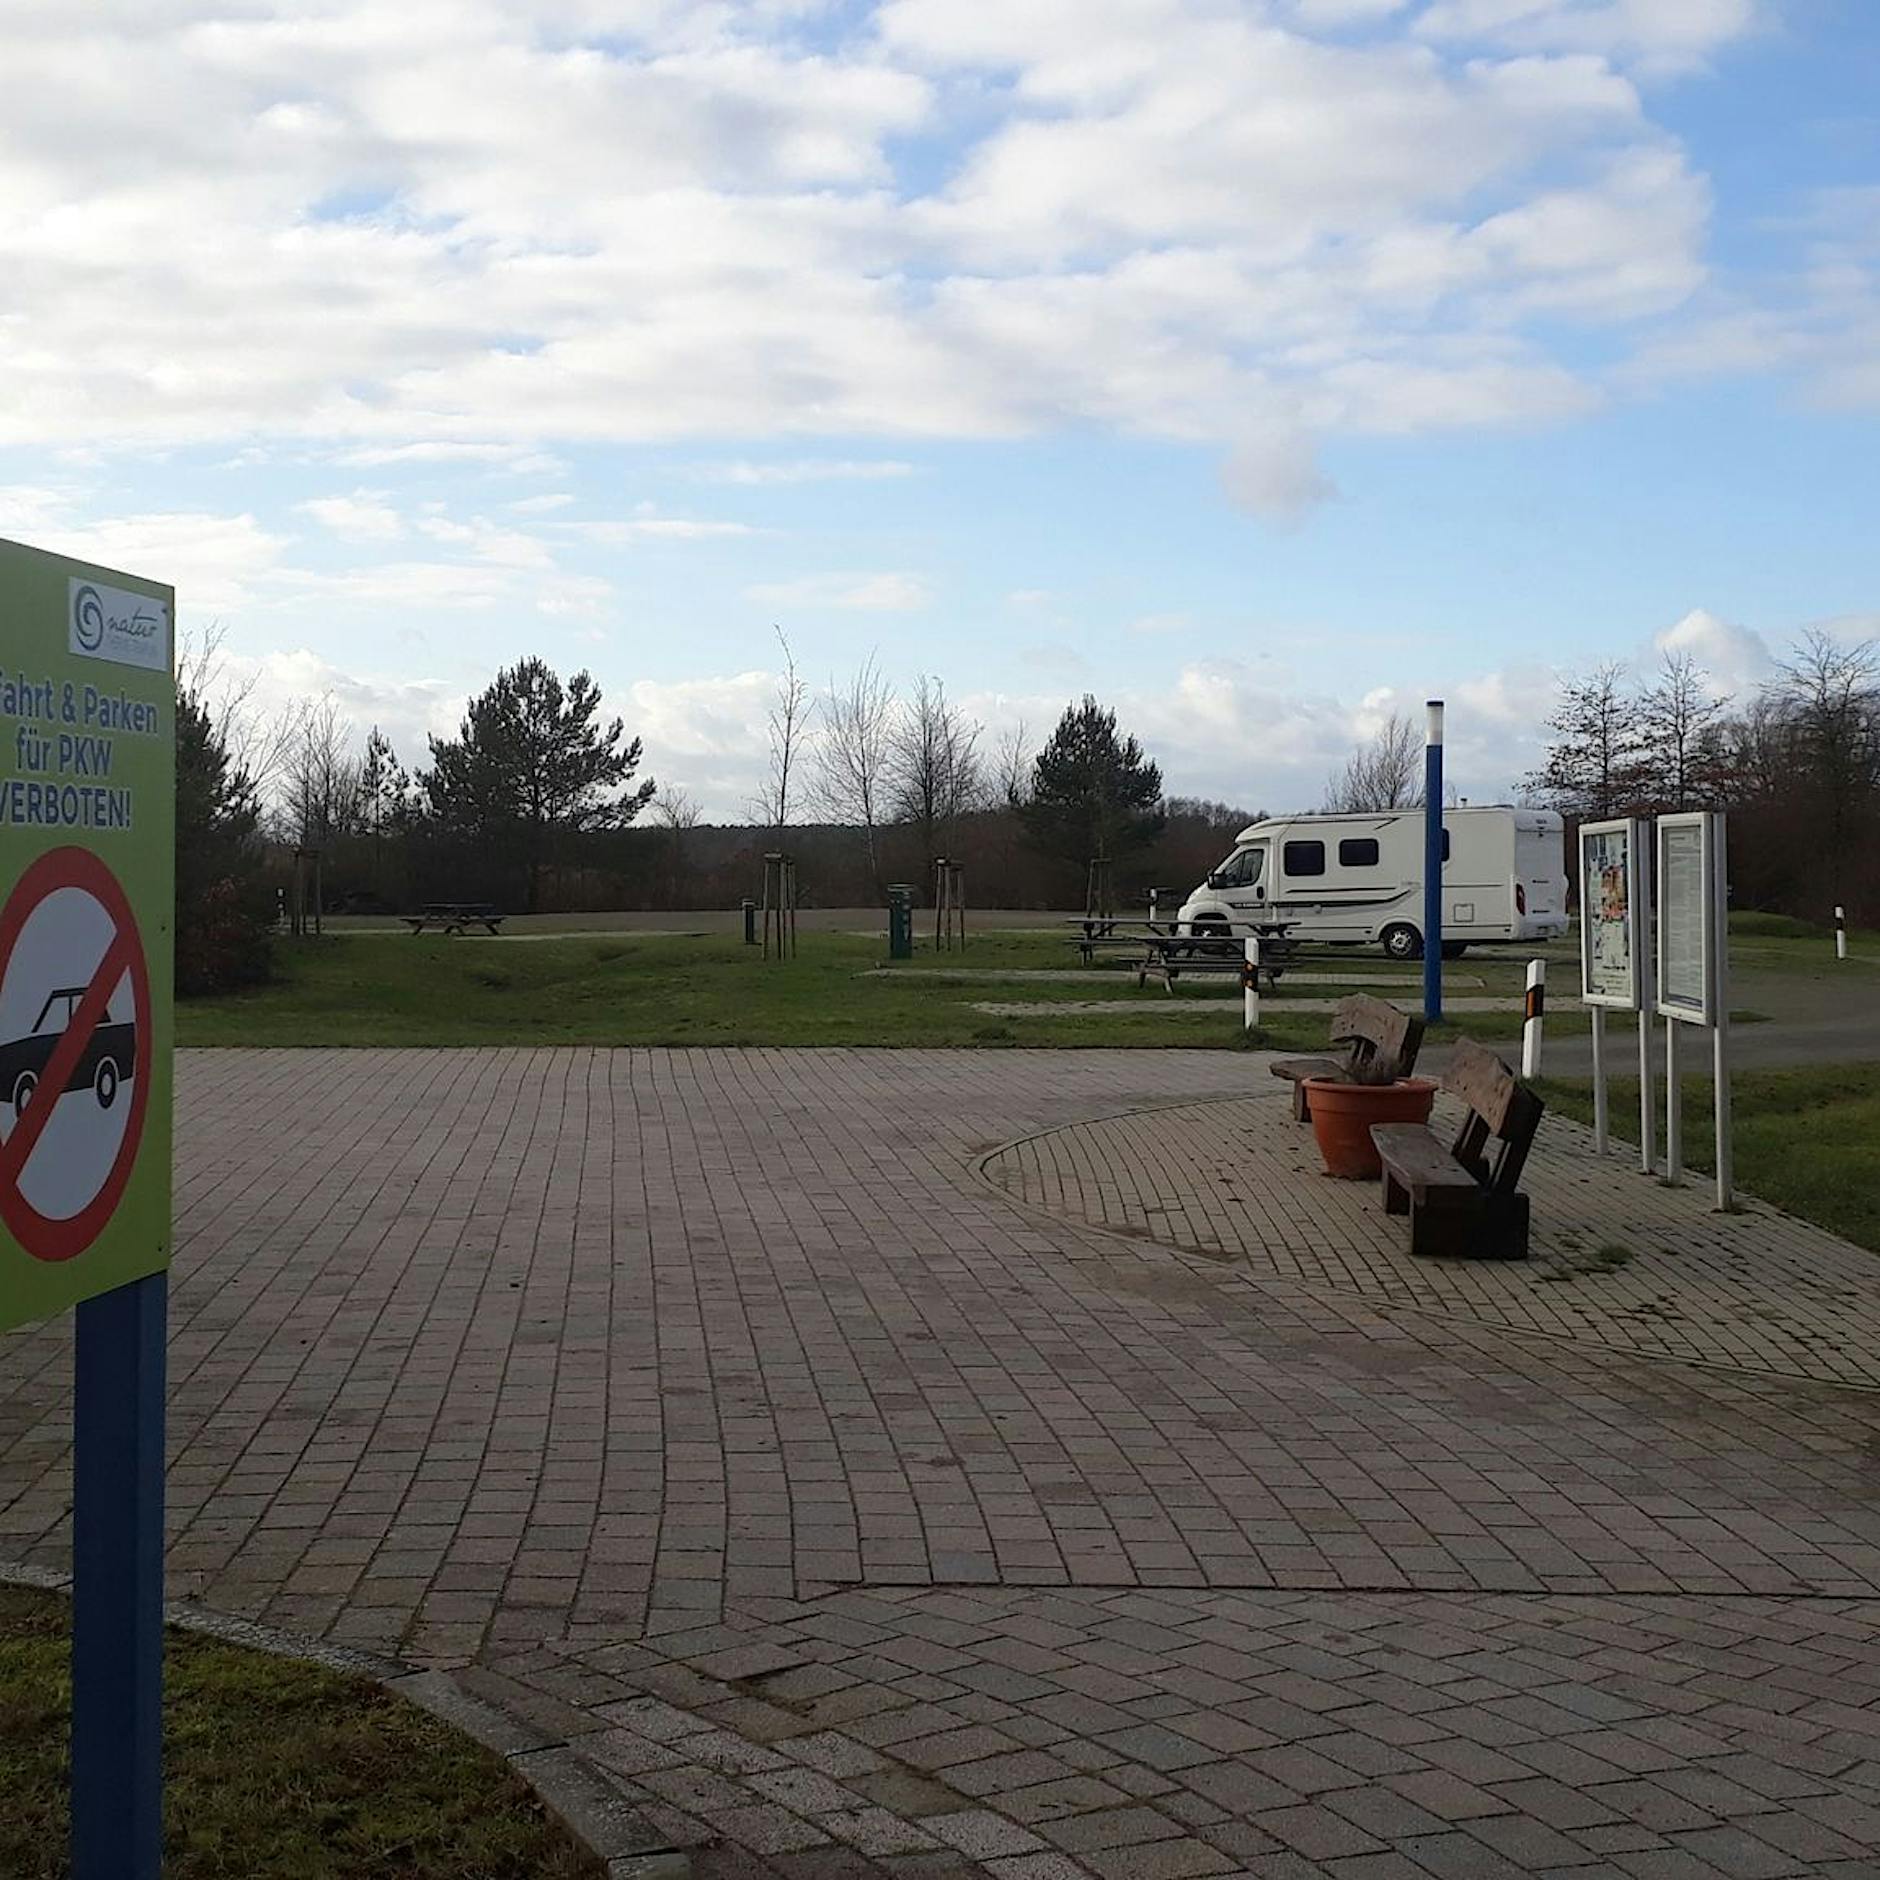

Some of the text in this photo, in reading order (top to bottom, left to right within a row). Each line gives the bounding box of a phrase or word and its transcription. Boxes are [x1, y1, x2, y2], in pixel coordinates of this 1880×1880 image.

[0, 671, 158, 733] ahrt & Parken
[17, 726, 112, 776] für PKW
